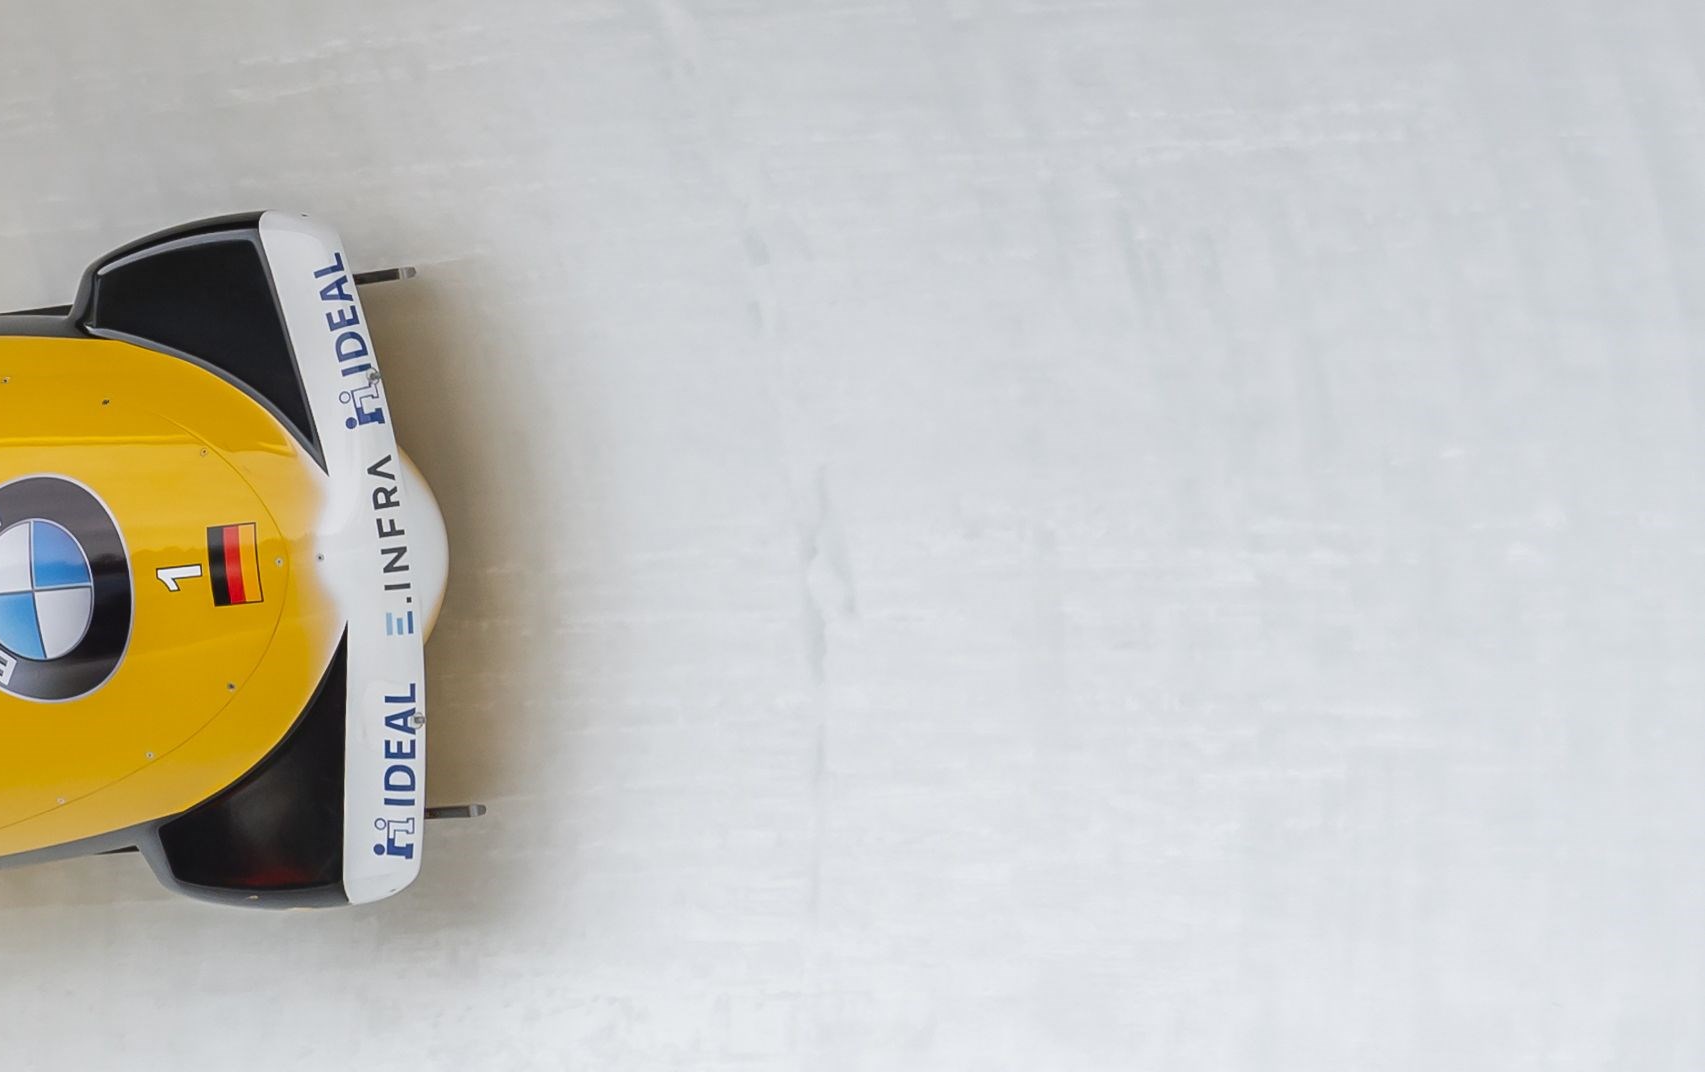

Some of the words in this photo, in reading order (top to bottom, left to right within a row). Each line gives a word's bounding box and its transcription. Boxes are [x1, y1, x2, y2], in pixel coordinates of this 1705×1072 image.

[313, 252, 372, 377] IDEAL
[155, 563, 203, 592] 1
[384, 682, 417, 807] IDEAL
